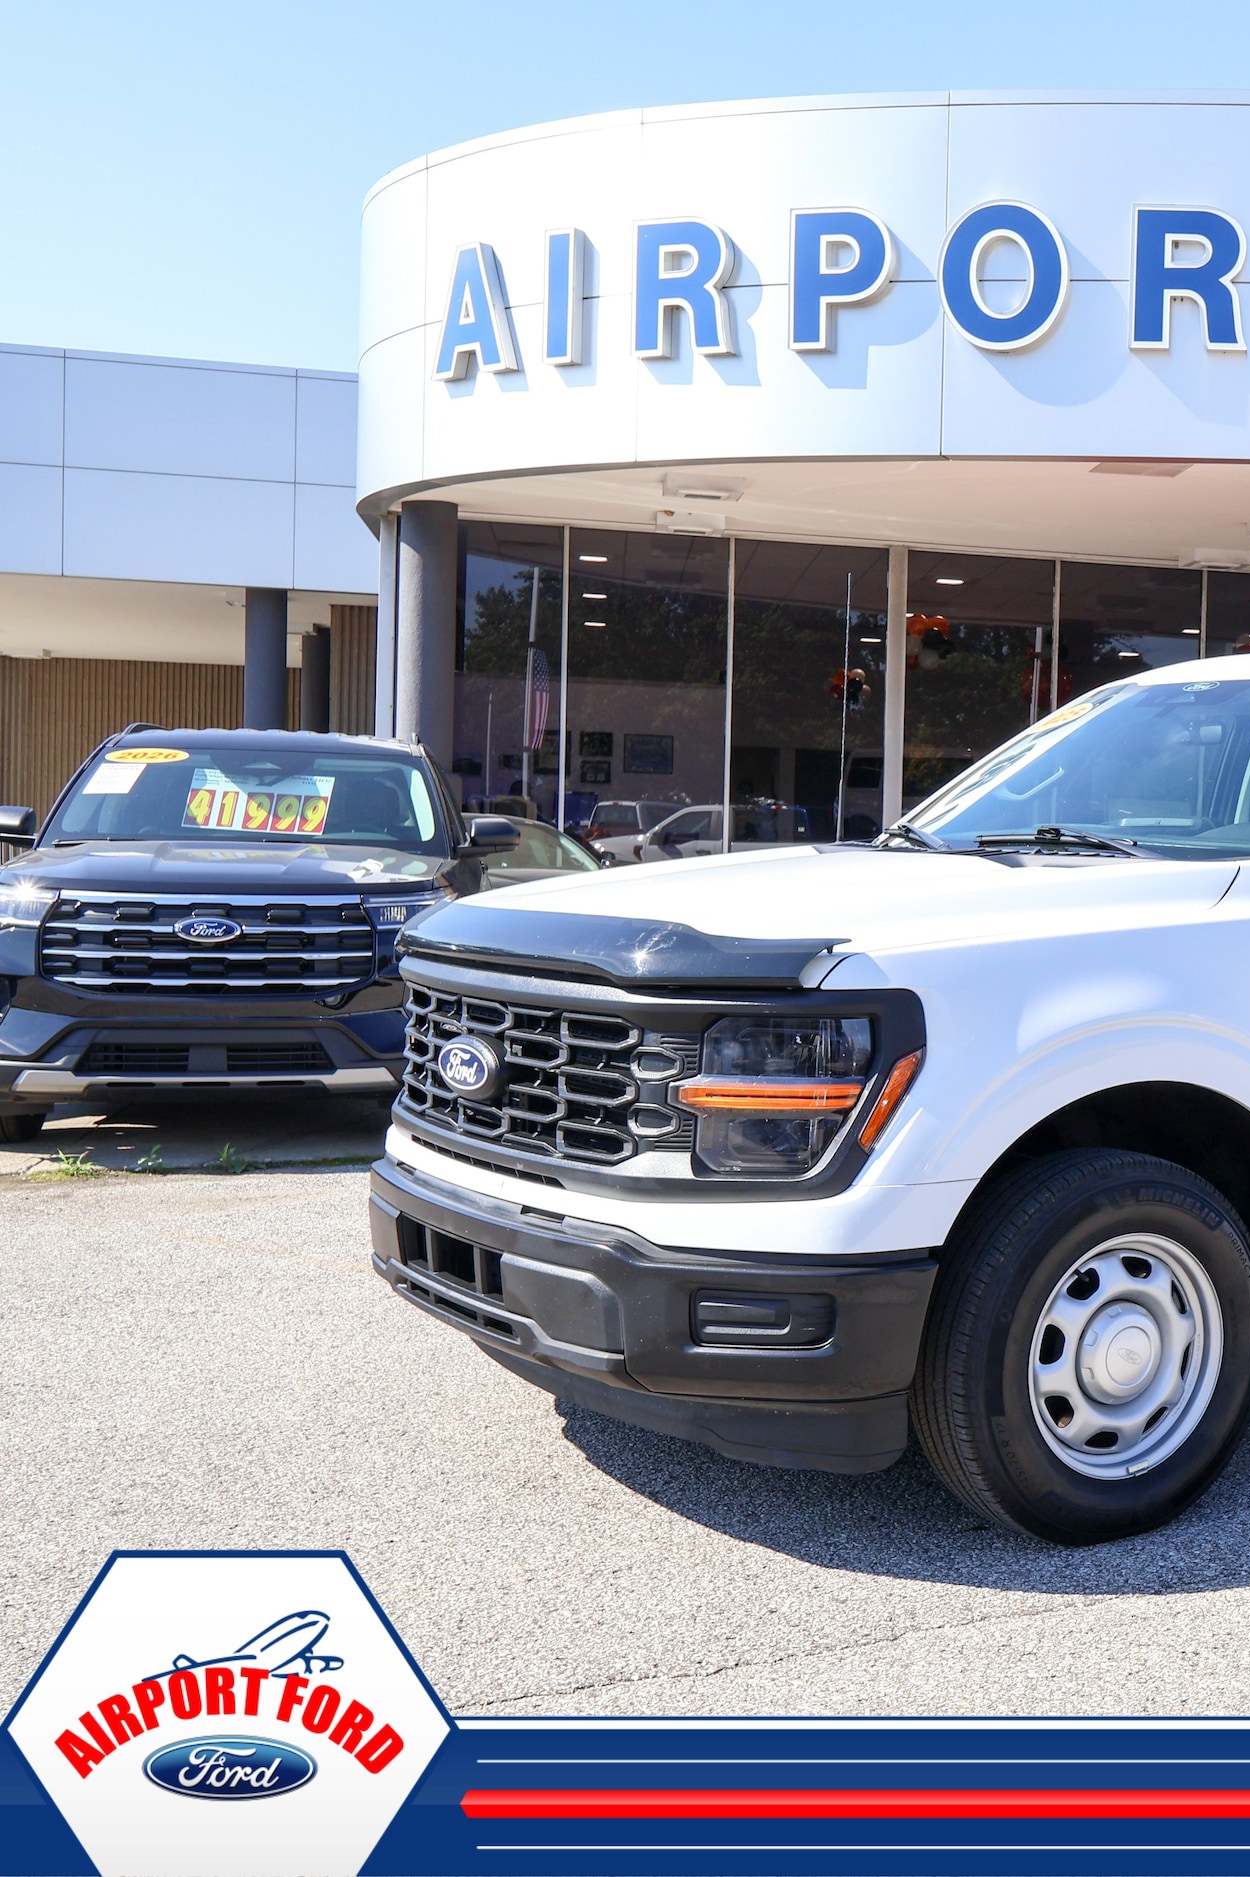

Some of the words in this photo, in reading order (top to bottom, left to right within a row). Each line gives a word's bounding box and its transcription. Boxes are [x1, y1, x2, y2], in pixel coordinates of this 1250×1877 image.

[116, 751, 179, 761] 2026
[187, 789, 327, 832] 41999
[189, 922, 227, 937] Ford
[446, 1048, 479, 1084] Ford
[1138, 1187, 1221, 1227] MICHELIN
